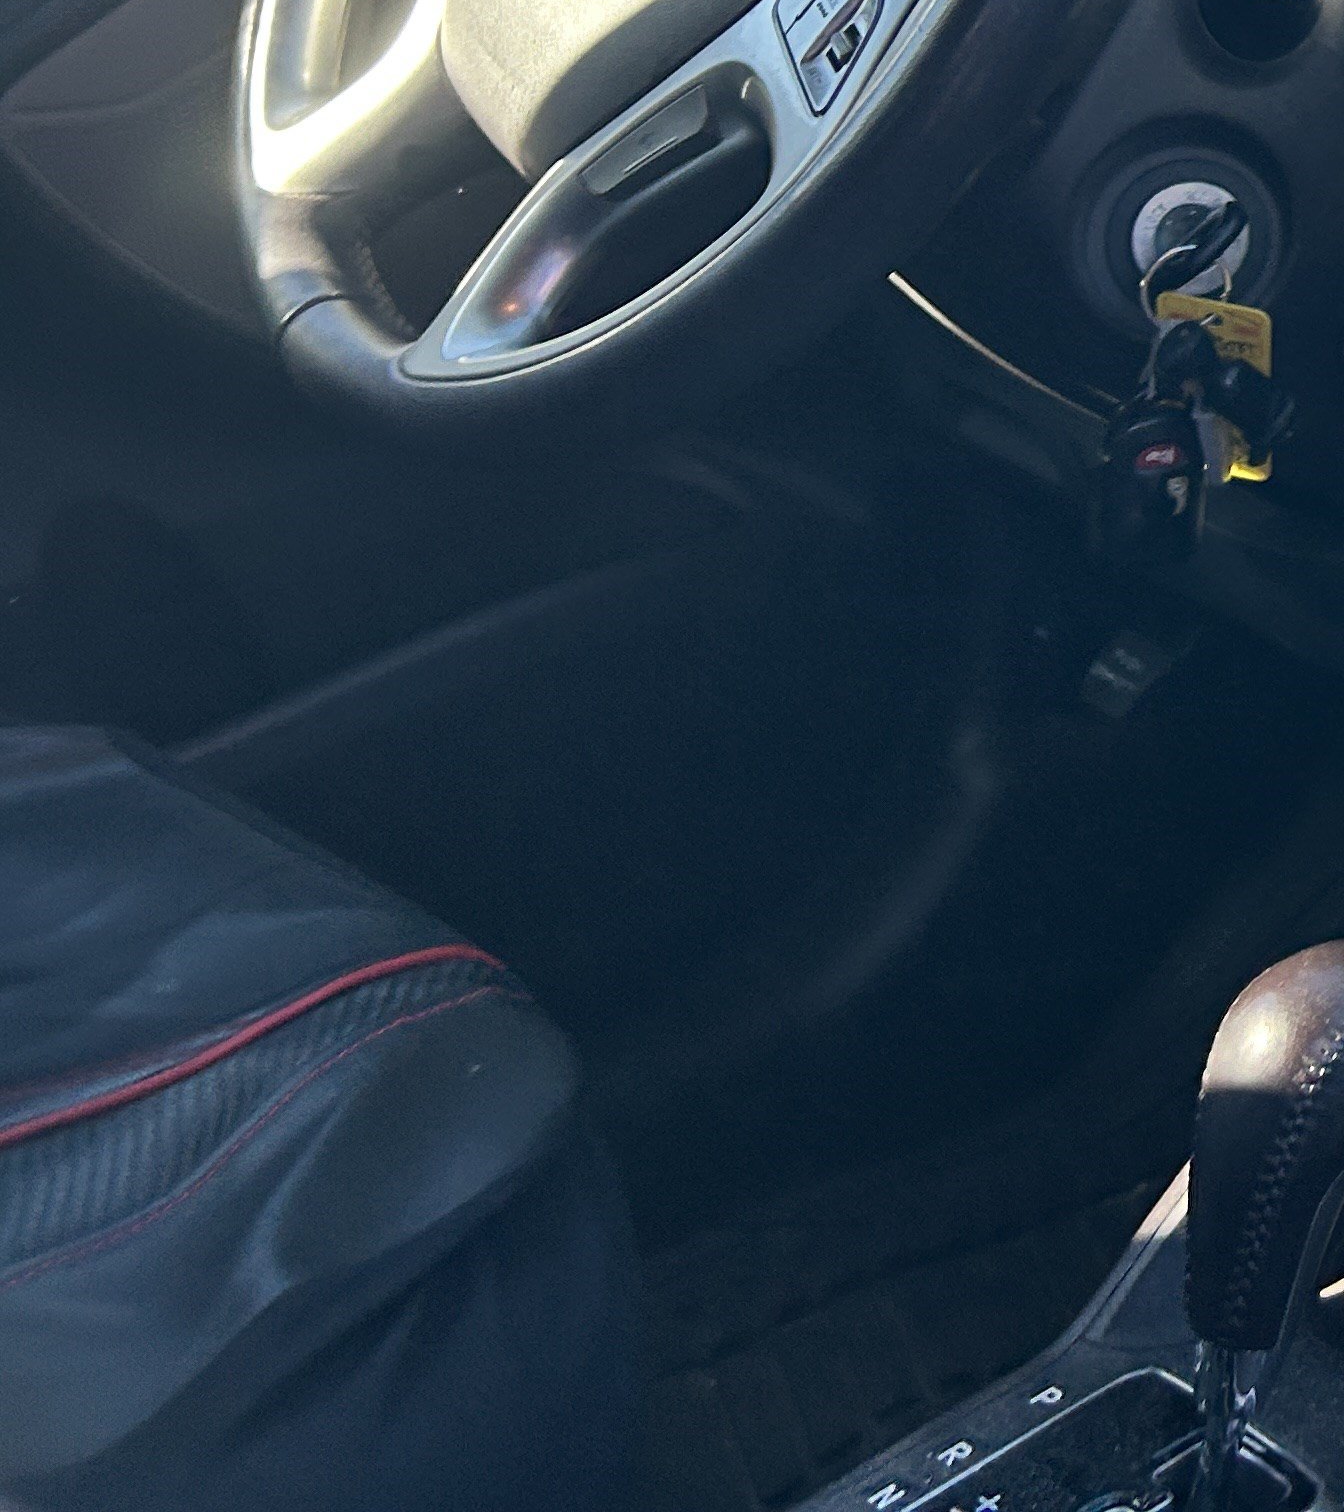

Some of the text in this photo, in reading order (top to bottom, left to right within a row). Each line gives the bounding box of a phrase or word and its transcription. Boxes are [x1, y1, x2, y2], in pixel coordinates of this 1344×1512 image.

[1029, 1385, 1064, 1406] P
[937, 1440, 975, 1467] R
[867, 1482, 906, 1510] N
